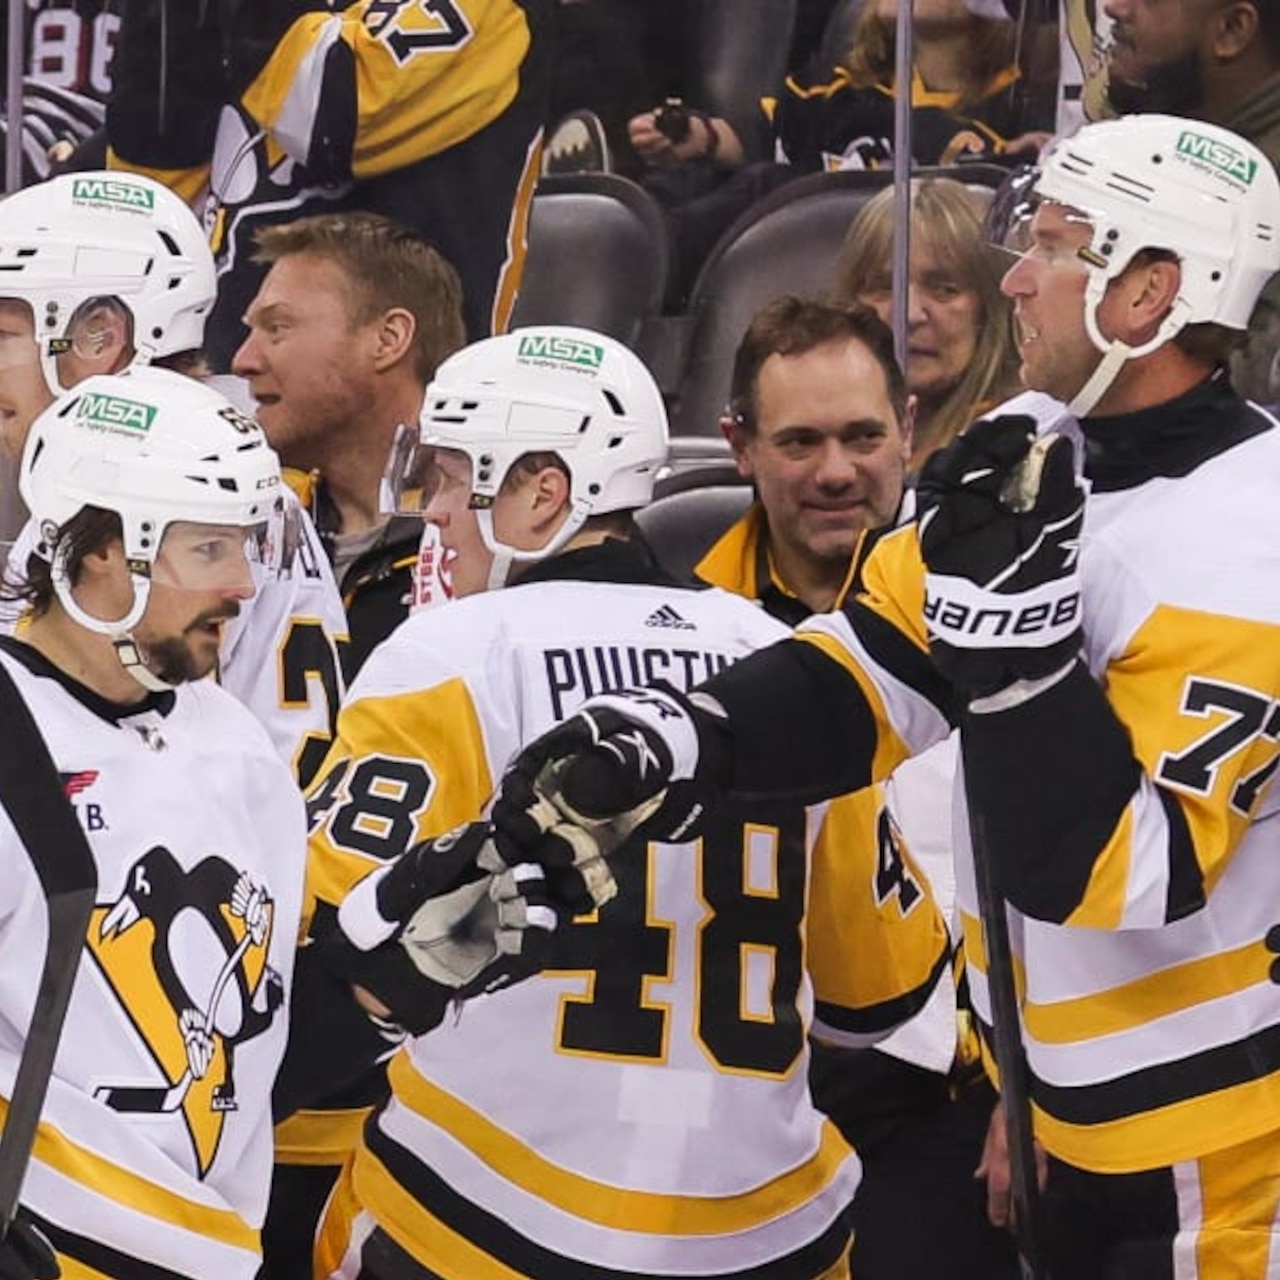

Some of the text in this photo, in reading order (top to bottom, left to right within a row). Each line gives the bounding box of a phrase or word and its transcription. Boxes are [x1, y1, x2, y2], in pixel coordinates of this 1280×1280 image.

[1179, 133, 1252, 182] MSA
[75, 180, 151, 207] MSA
[520, 337, 602, 366] MSA
[81, 395, 153, 431] MSA
